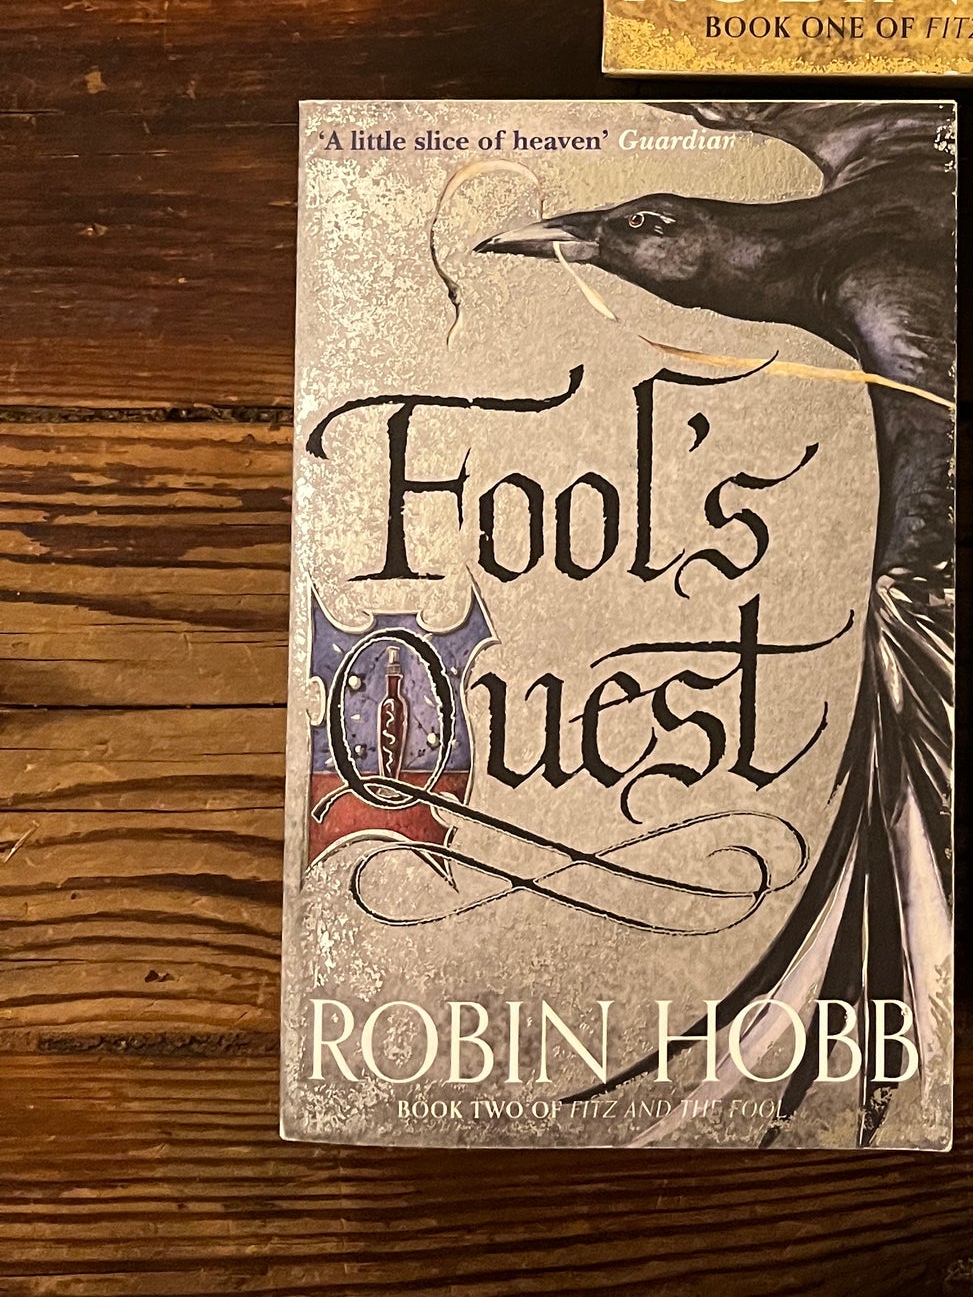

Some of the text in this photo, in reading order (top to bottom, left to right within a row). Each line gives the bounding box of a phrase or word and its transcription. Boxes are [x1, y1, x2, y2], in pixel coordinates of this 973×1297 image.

[705, 16, 791, 39] BOOK
[801, 16, 864, 39] ONE
[875, 16, 915, 39] OF
[319, 128, 736, 151] ‘A little slice of heaven’ Guardian
[306, 350, 819, 600] Fool’s
[311, 595, 855, 842] Quest
[308, 998, 921, 1084] ROBIN HOBB
[398, 1100, 463, 1119] BOOK
[470, 1100, 524, 1119] TWO
[531, 1100, 563, 1119] OF
[570, 1100, 618, 1119] FITZ
[623, 1100, 672, 1119] AND
[729, 1100, 787, 1119] FOOL
